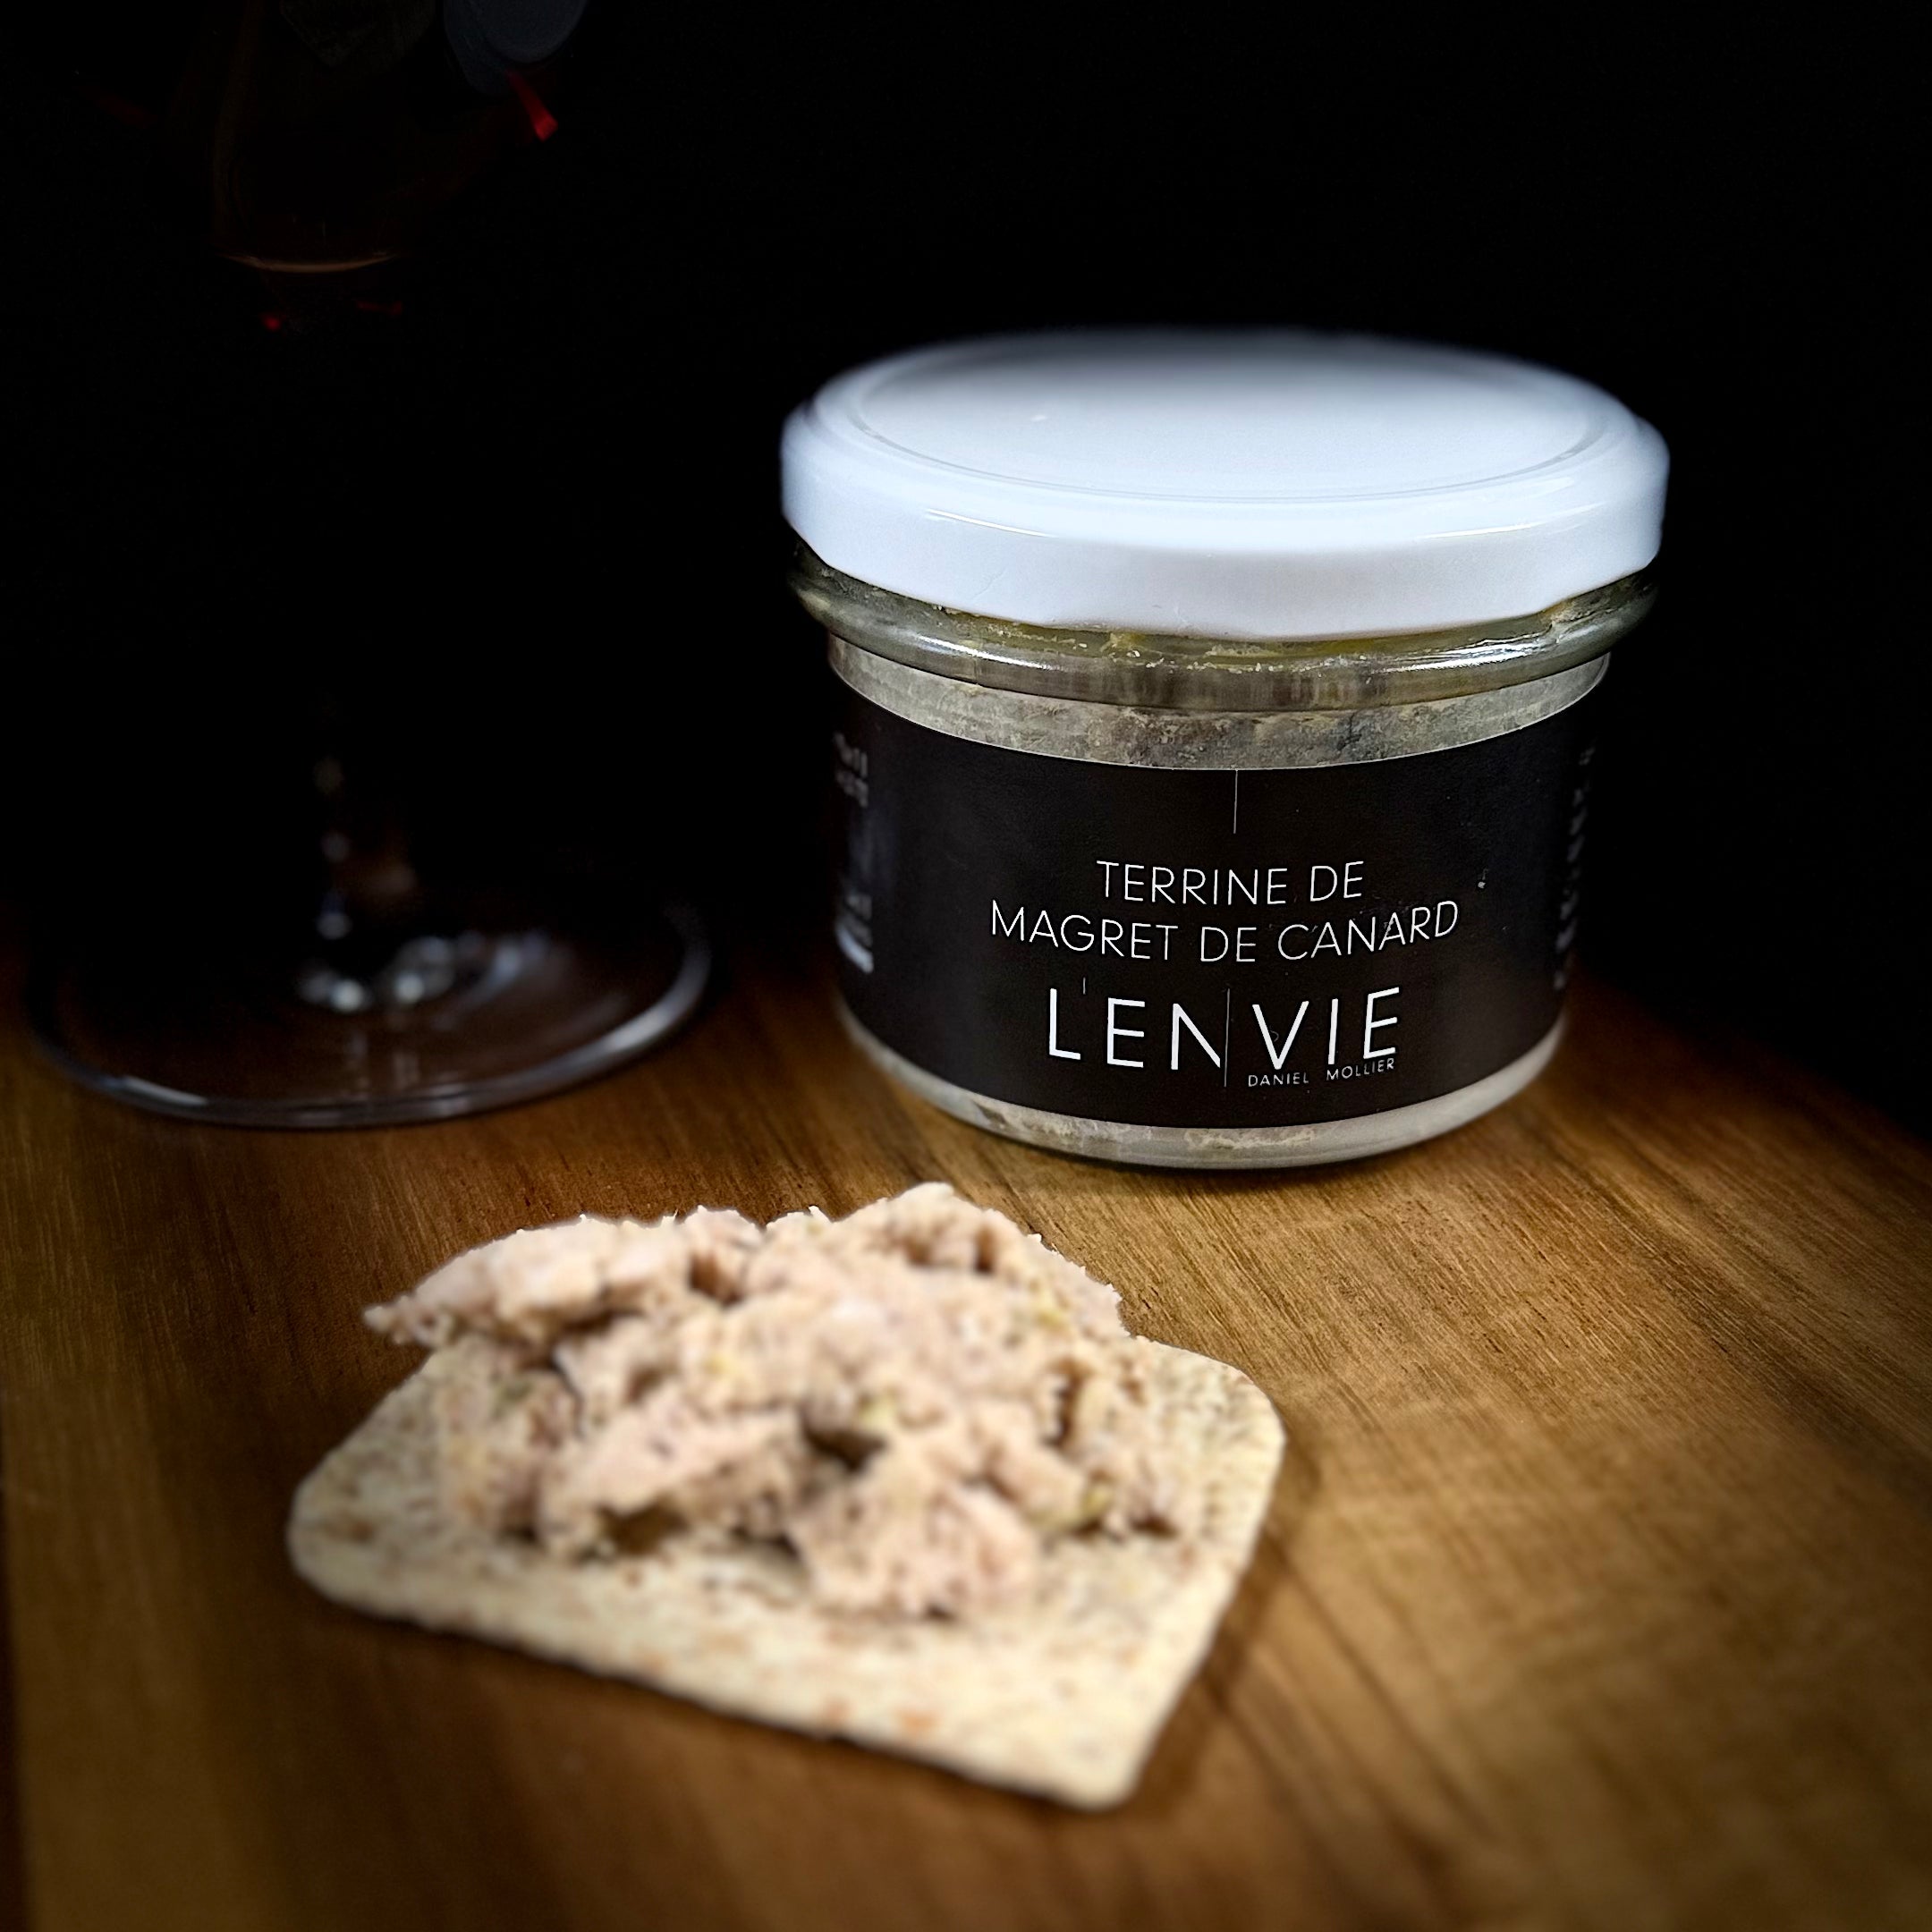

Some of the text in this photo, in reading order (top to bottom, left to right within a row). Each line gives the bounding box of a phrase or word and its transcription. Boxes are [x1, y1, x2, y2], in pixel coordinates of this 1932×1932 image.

[1096, 860, 1364, 905] TERRINE DE
[991, 899, 1460, 963] MAGRET DE CANARD
[1248, 1057, 1395, 1088] DANIEL MOLLIER
